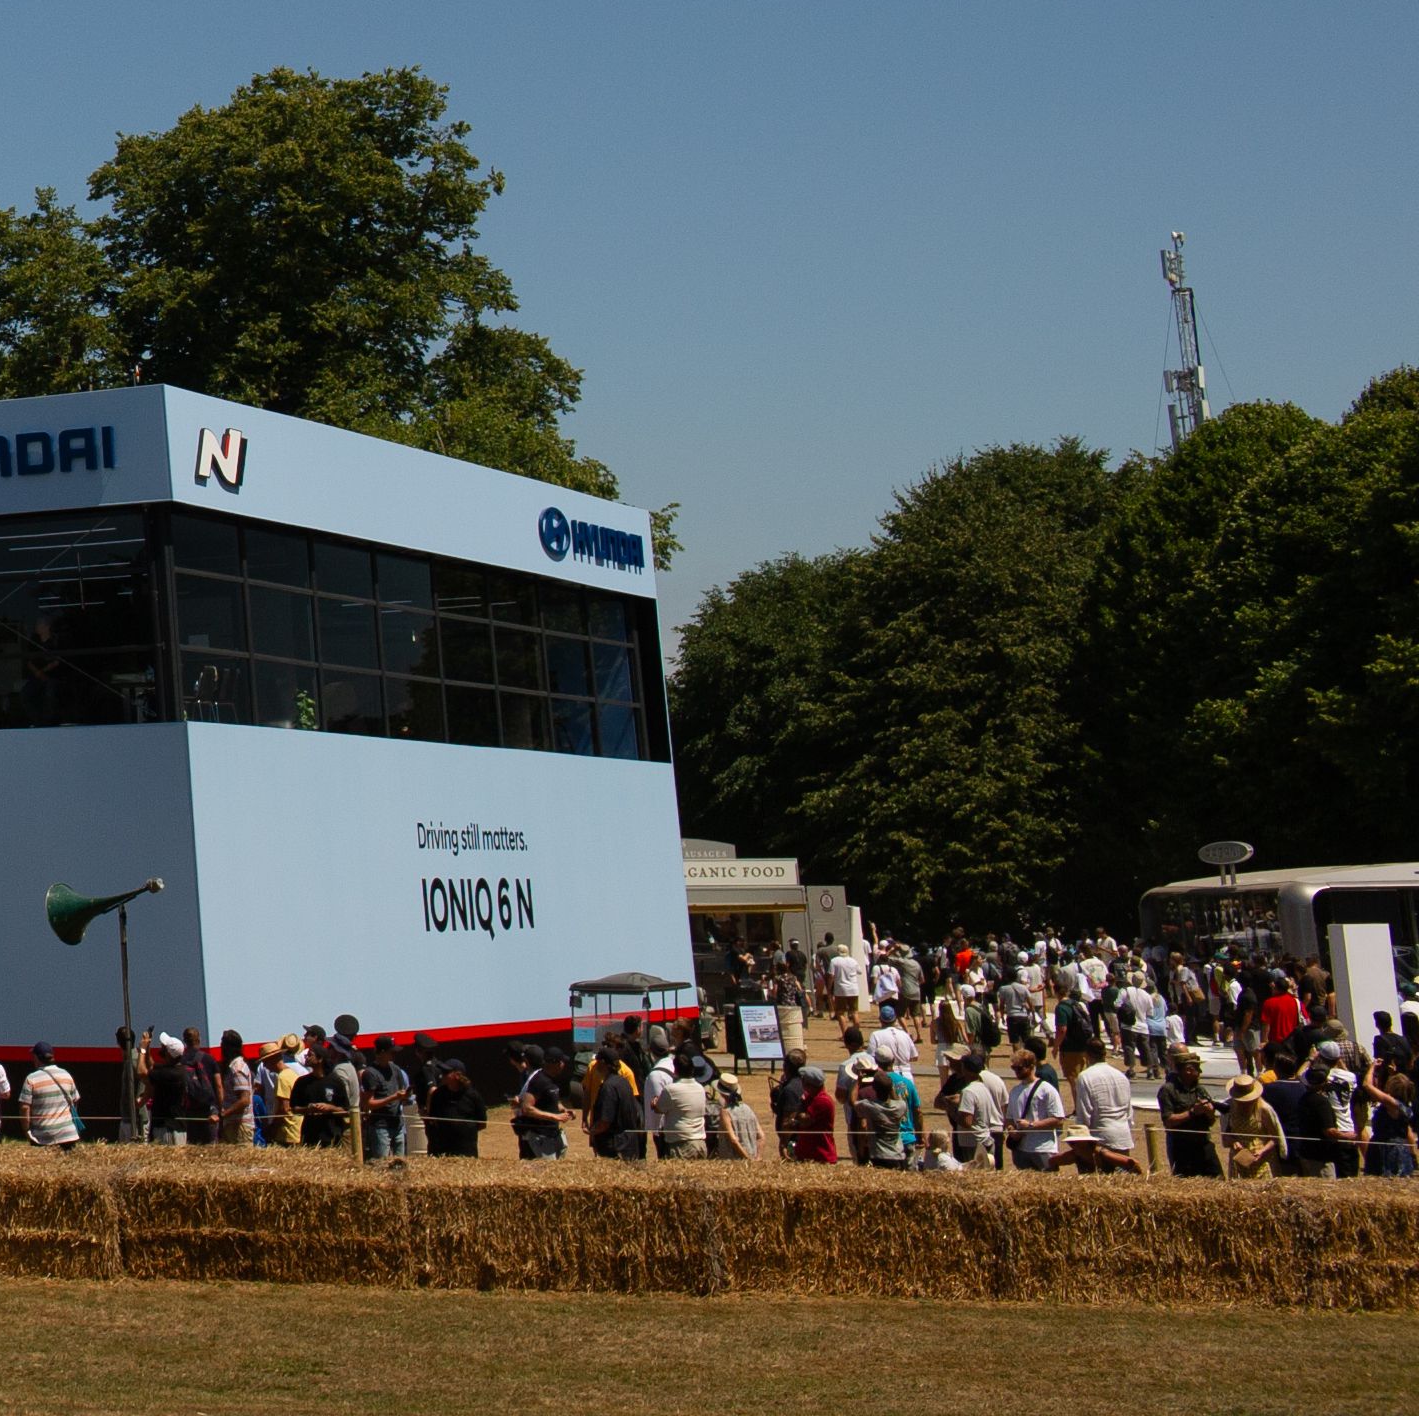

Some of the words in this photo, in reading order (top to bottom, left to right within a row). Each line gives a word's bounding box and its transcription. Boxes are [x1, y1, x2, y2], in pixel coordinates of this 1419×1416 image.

[195, 428, 248, 488] N
[571, 519, 645, 569] HYUNDAI
[417, 821, 459, 856] Driving
[461, 822, 481, 850] still
[482, 826, 528, 851] matters.
[684, 866, 737, 878] GANIC
[743, 866, 786, 878] FOOD
[421, 877, 495, 941] IONIQ
[497, 877, 512, 931] 6
[515, 878, 535, 929] N
